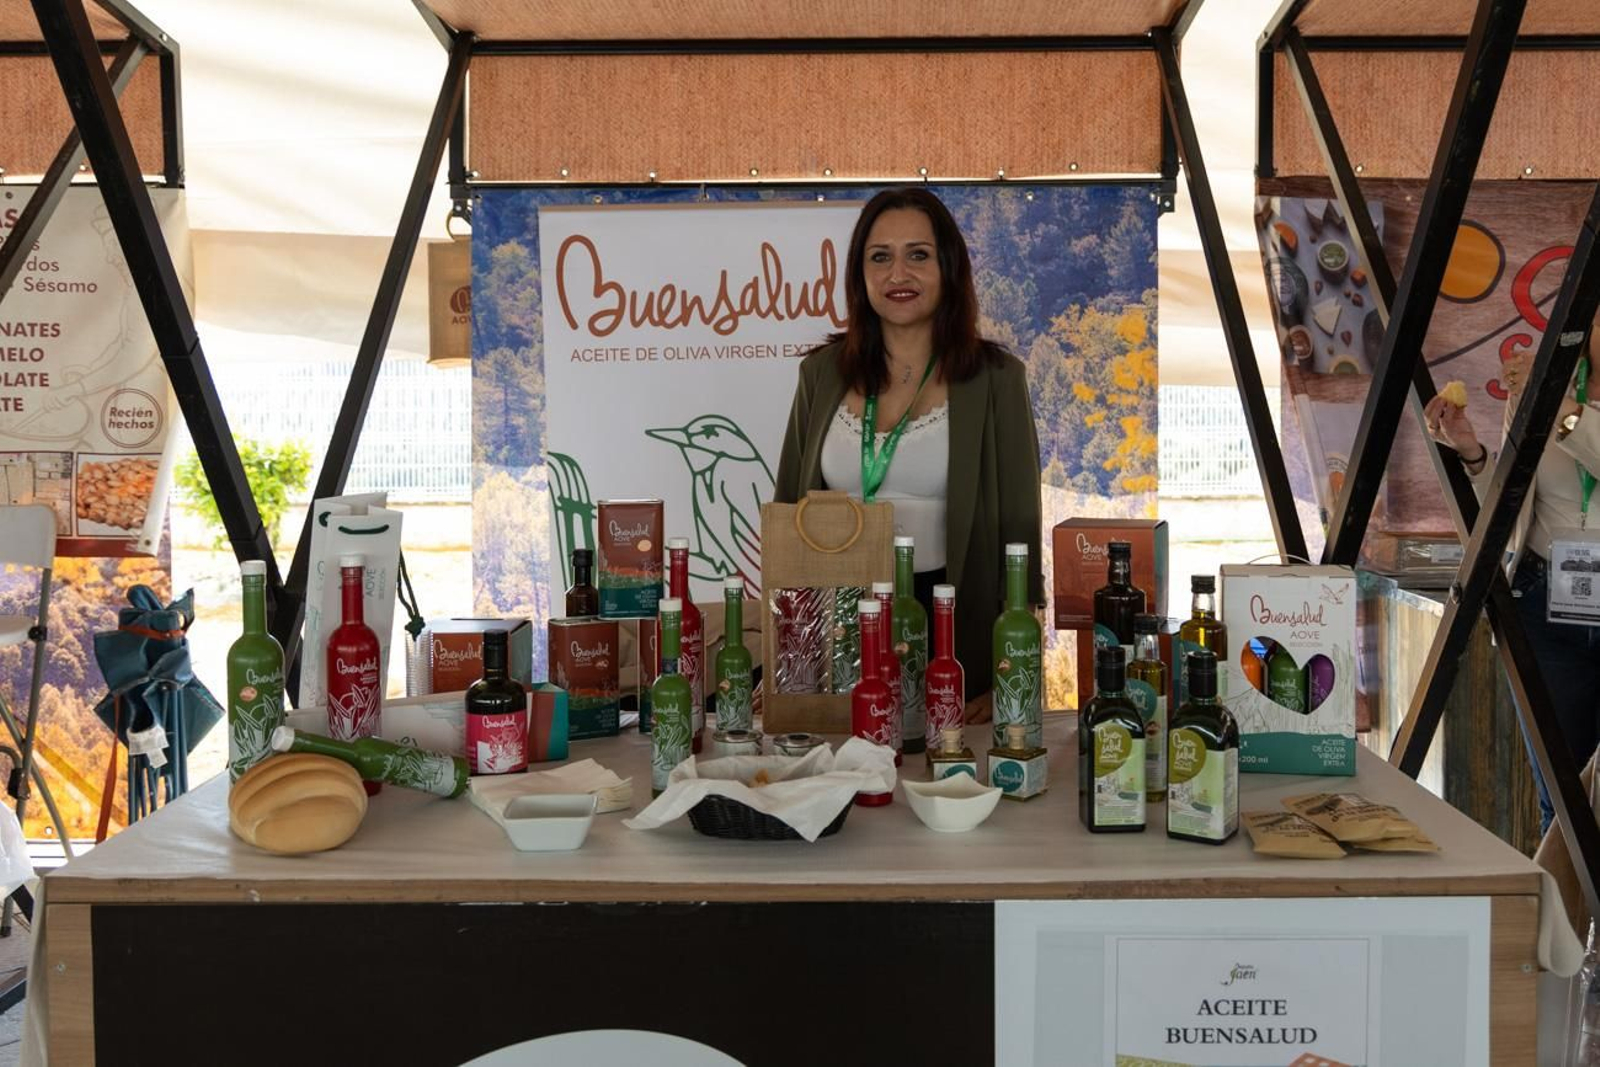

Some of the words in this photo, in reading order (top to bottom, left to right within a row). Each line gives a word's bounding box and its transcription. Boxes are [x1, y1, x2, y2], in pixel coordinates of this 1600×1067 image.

[23, 276, 98, 293] Sésamo
[556, 234, 848, 337] Buensalud
[570, 348, 631, 362] ACEITE
[636, 347, 658, 361] DE
[663, 346, 711, 361] OLIVA
[714, 345, 778, 359] VIRGEN
[783, 343, 822, 358] EXT
[0, 372, 50, 387] LATE
[0, 397, 25, 412] TE
[109, 406, 153, 418] Recién
[108, 420, 154, 429] hechos
[366, 568, 376, 597] AOVE
[1250, 594, 1328, 627] Buensalud
[1290, 630, 1320, 640] AOVE
[1197, 999, 1288, 1016] ACEITE
[1165, 1027, 1318, 1045] BUENSALUD
